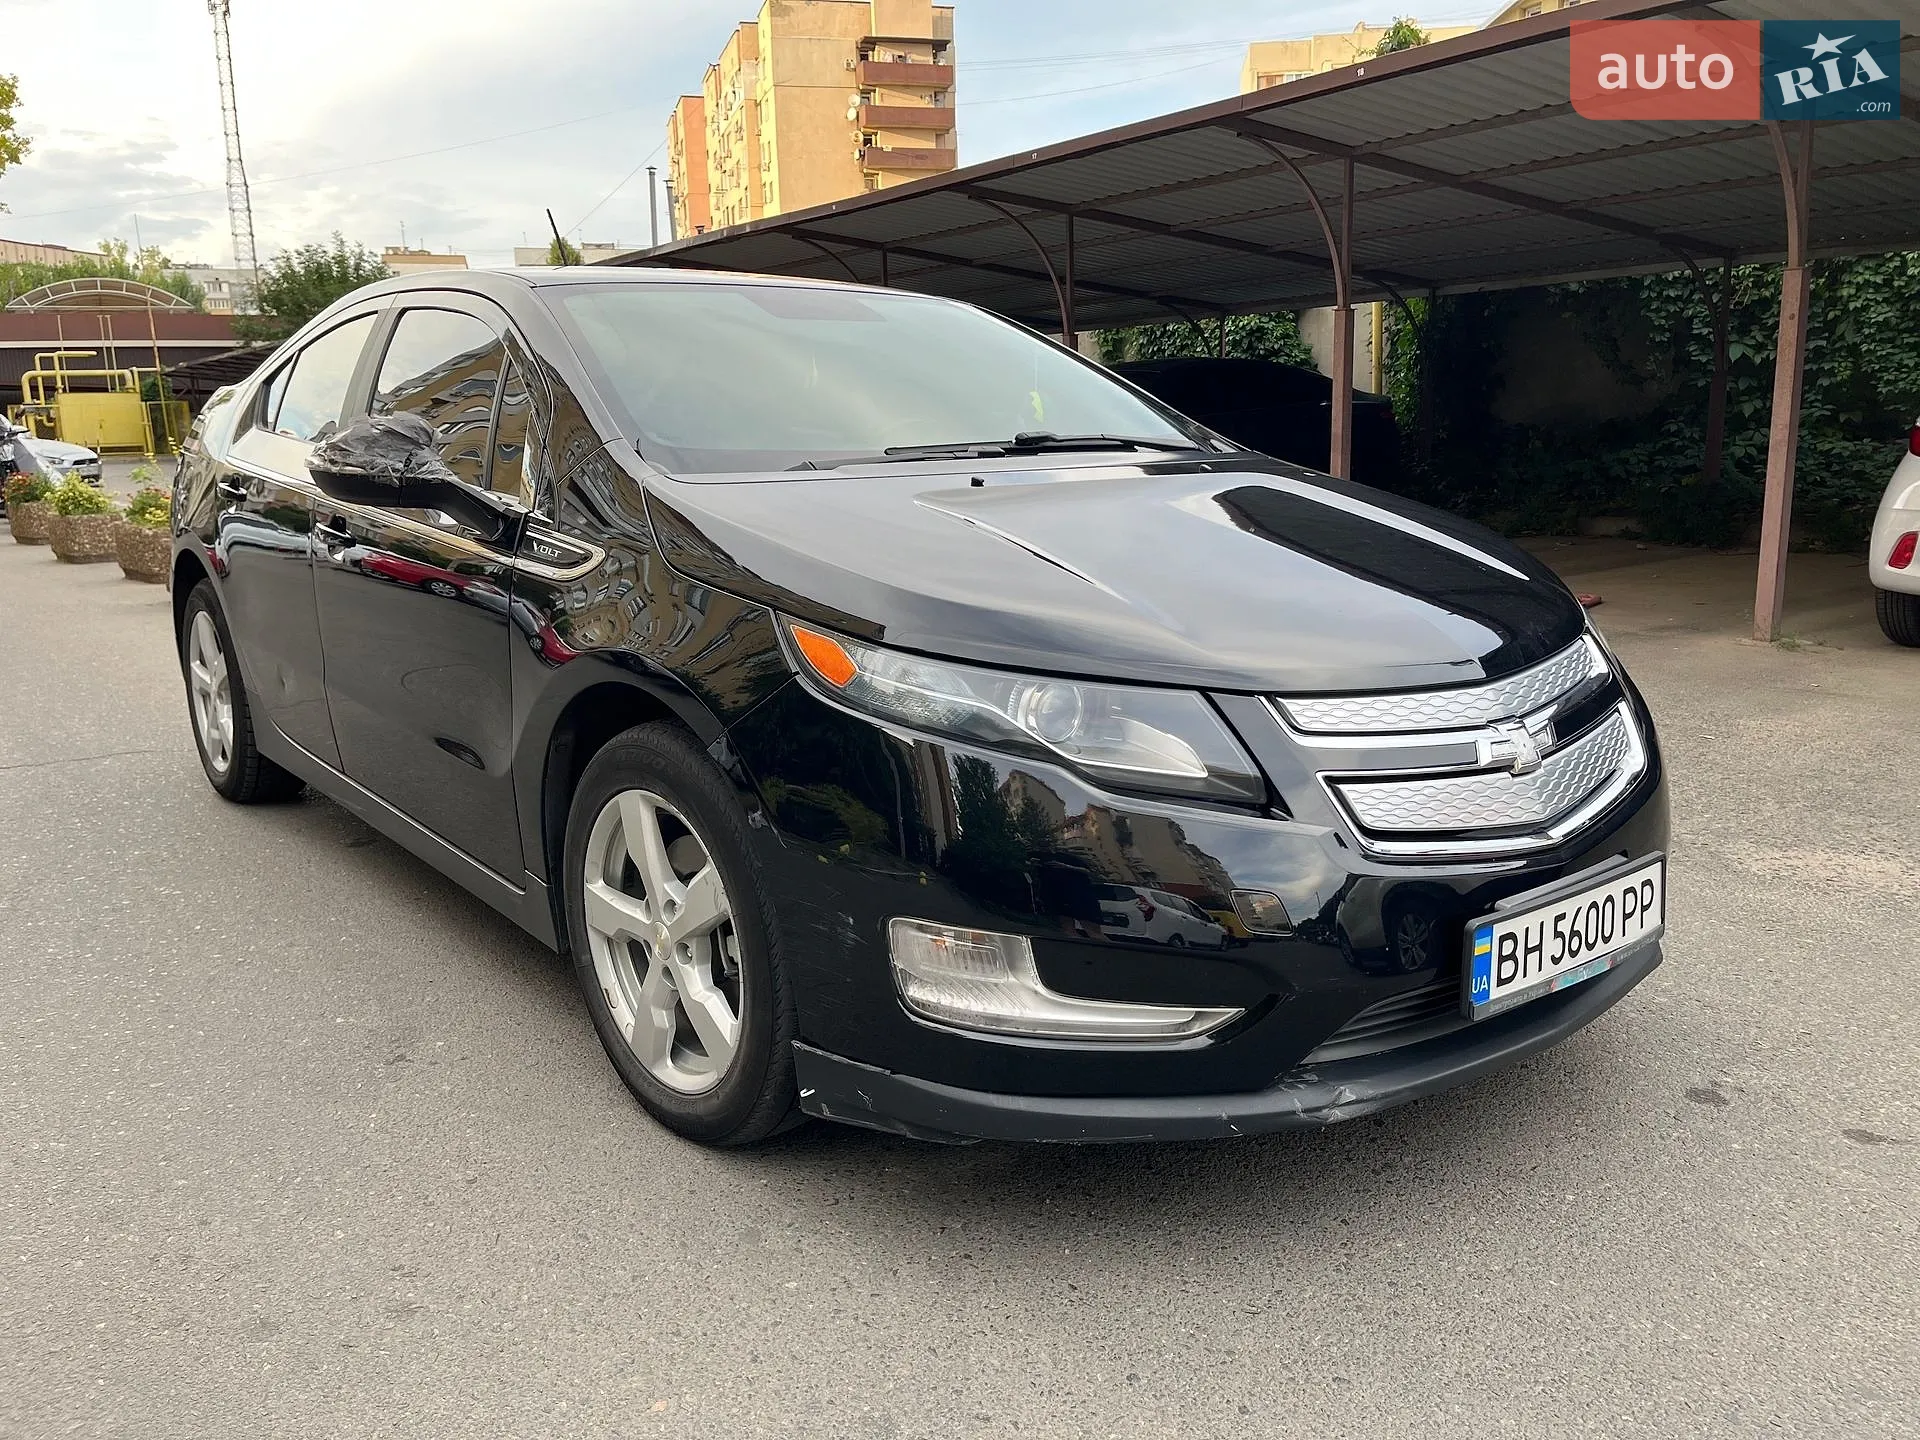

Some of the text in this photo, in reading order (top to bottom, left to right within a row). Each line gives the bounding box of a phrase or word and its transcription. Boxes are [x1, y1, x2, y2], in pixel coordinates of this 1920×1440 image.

[532, 540, 562, 558] VOLT
[1496, 878, 1655, 988] BH 5600 PP
[1471, 976, 1489, 994] UA
